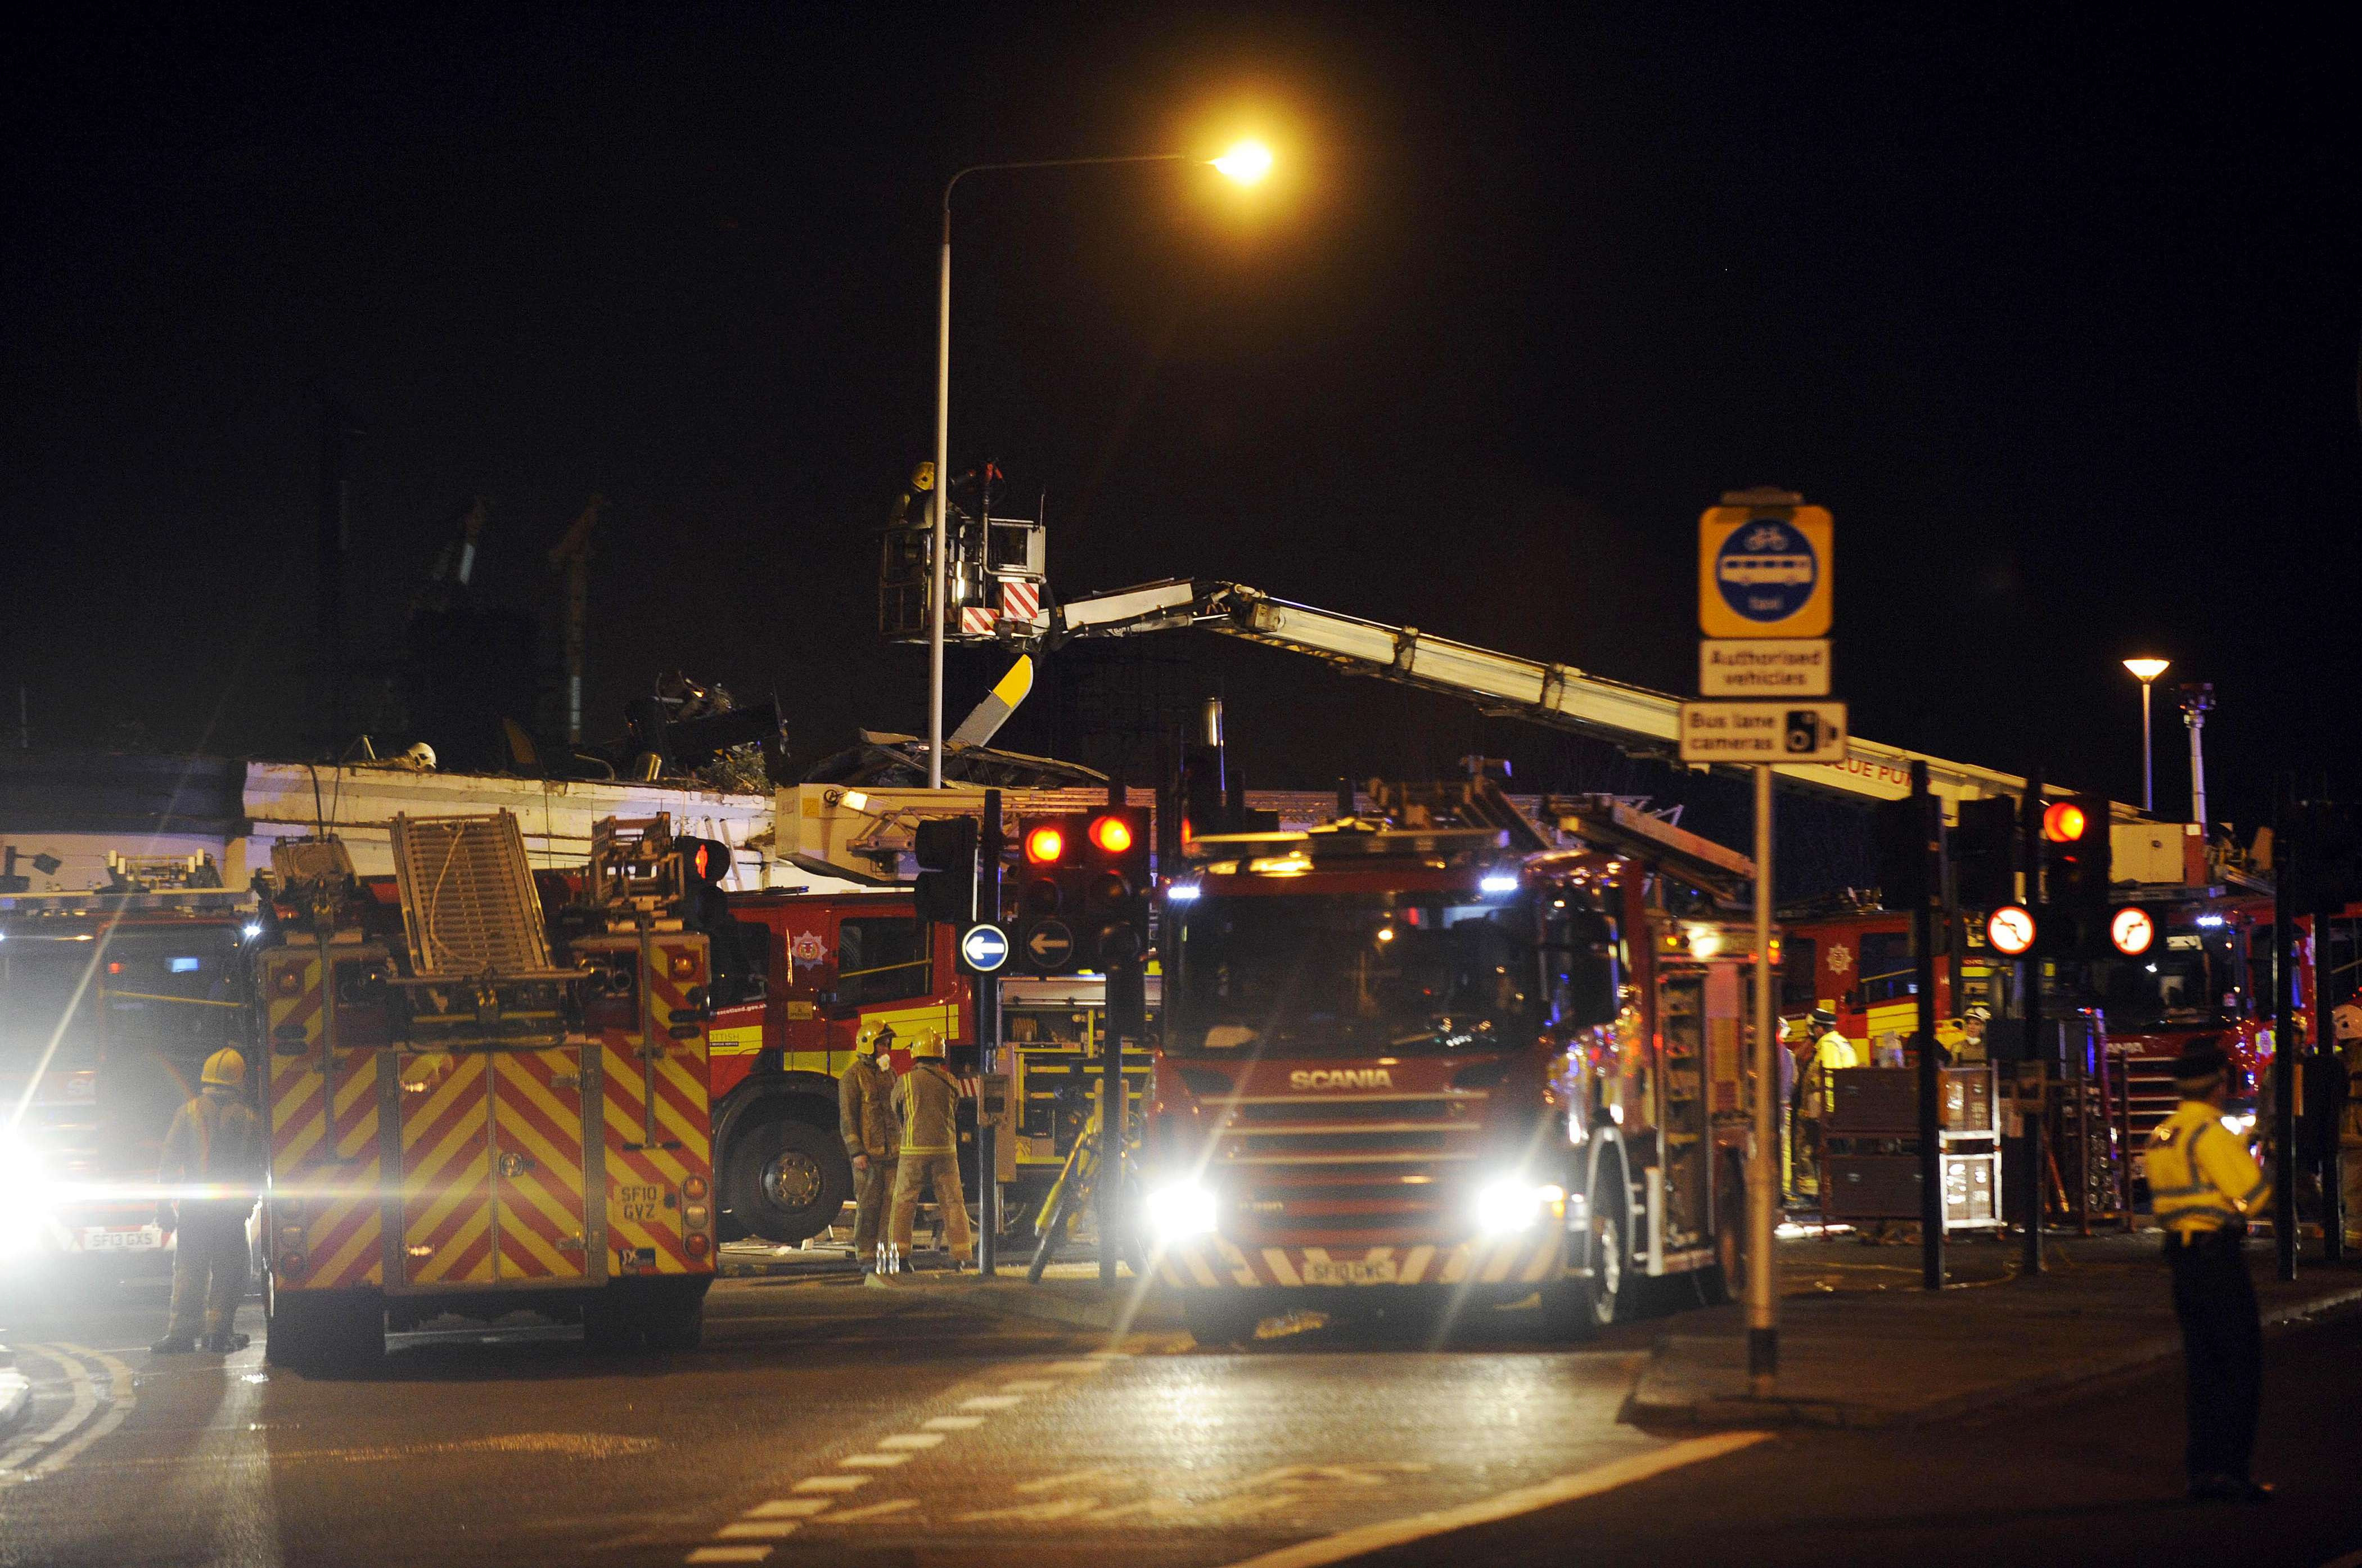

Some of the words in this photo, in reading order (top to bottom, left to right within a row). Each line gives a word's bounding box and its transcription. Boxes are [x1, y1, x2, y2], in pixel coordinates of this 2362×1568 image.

[1712, 650, 1821, 666] Authorised
[1724, 671, 1807, 686] vehicles
[1691, 711, 1727, 729] Bus
[1733, 711, 1775, 729] lane
[1691, 738, 1774, 750] cameras
[1291, 1070, 1393, 1089] SCANIA
[621, 1186, 656, 1201] SF10
[624, 1203, 655, 1220] GVZ
[93, 1234, 122, 1246] SF13
[127, 1233, 152, 1245] GXS
